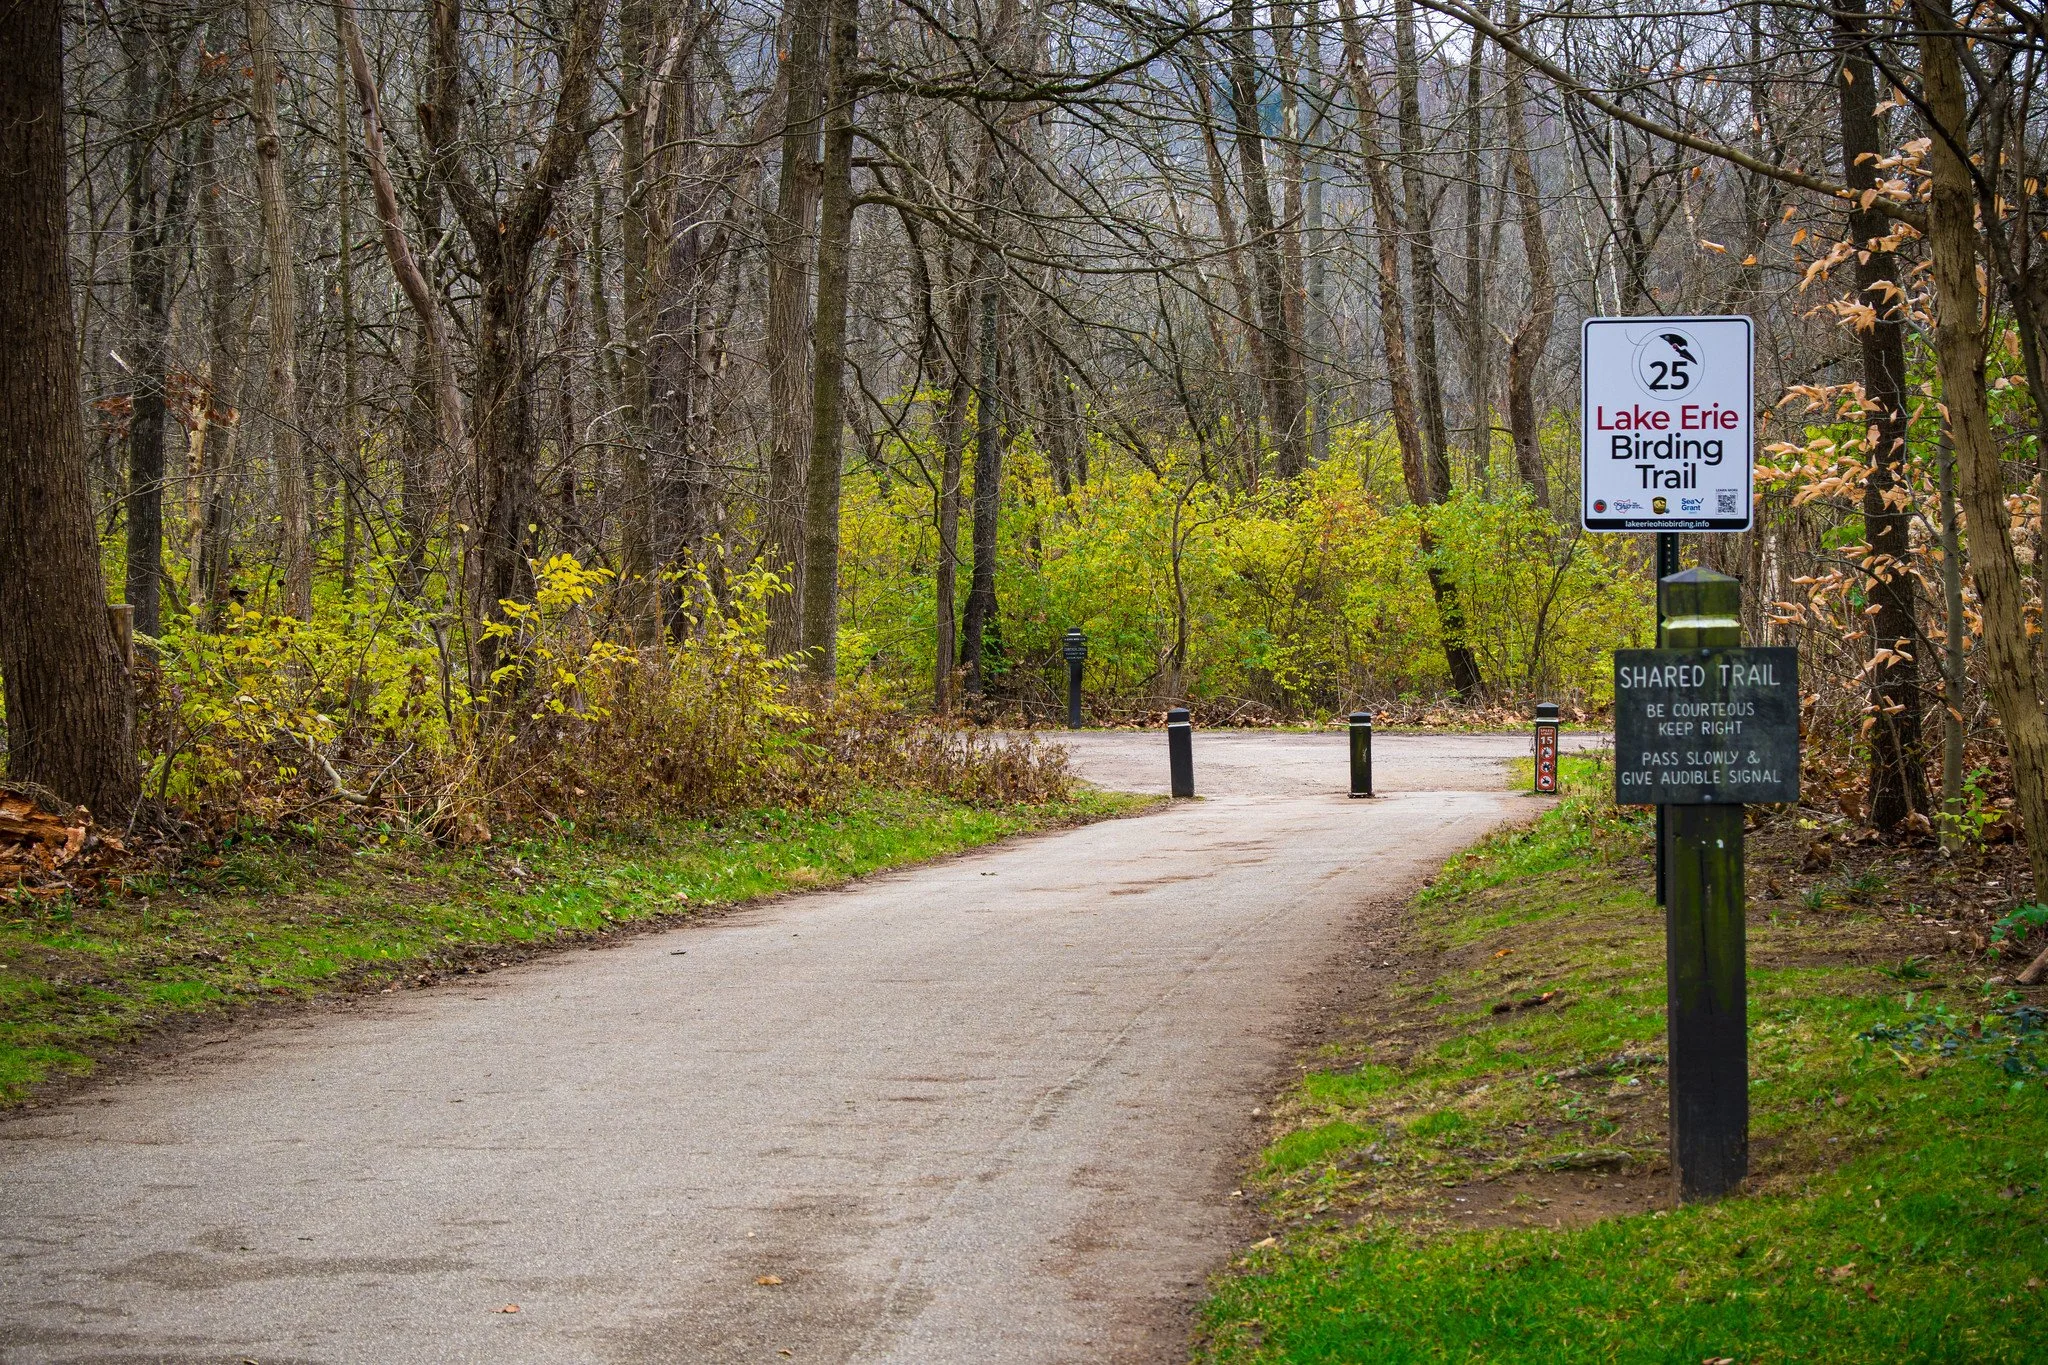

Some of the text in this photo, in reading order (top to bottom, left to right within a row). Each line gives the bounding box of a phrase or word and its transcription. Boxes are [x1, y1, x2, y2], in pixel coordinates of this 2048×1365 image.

[1649, 361, 1690, 390] 25
[1597, 403, 1739, 431] Lake Erie
[1611, 432, 1723, 466] Birding
[1635, 462, 1697, 489] Trail
[1625, 520, 1710, 529] lakeerieohiobirding.info
[1620, 664, 1781, 688] SHARED TRAIL
[1646, 702, 1755, 718] BE COURTEOUS
[1658, 720, 1743, 736] KEEP RIGHT
[1540, 736, 1553, 745] 15
[1642, 750, 1761, 766] PASS SLOWLY &
[1621, 769, 1782, 785] GIVE AUDIBLE SIGNAL
